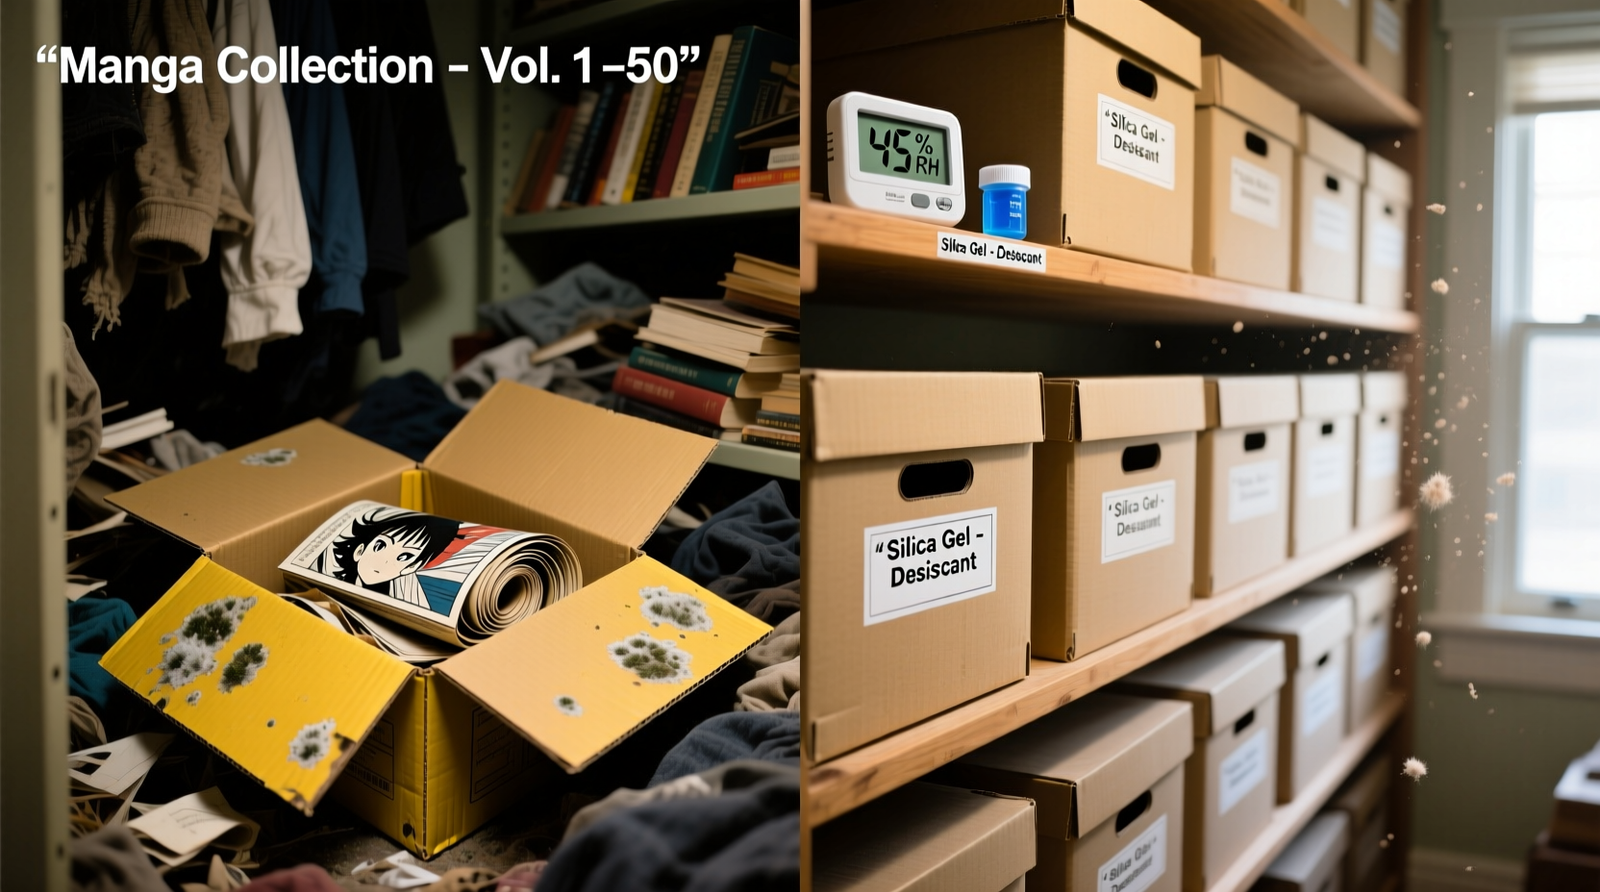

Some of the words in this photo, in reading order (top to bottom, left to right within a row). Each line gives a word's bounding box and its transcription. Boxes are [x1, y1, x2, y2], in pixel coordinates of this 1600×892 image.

[869, 127, 912, 173] 45
[915, 133, 933, 155] %
[916, 155, 939, 177] RH
[970, 241, 987, 257] Gel
[942, 525, 970, 549] Gel
[891, 551, 977, 588] Desiscant
